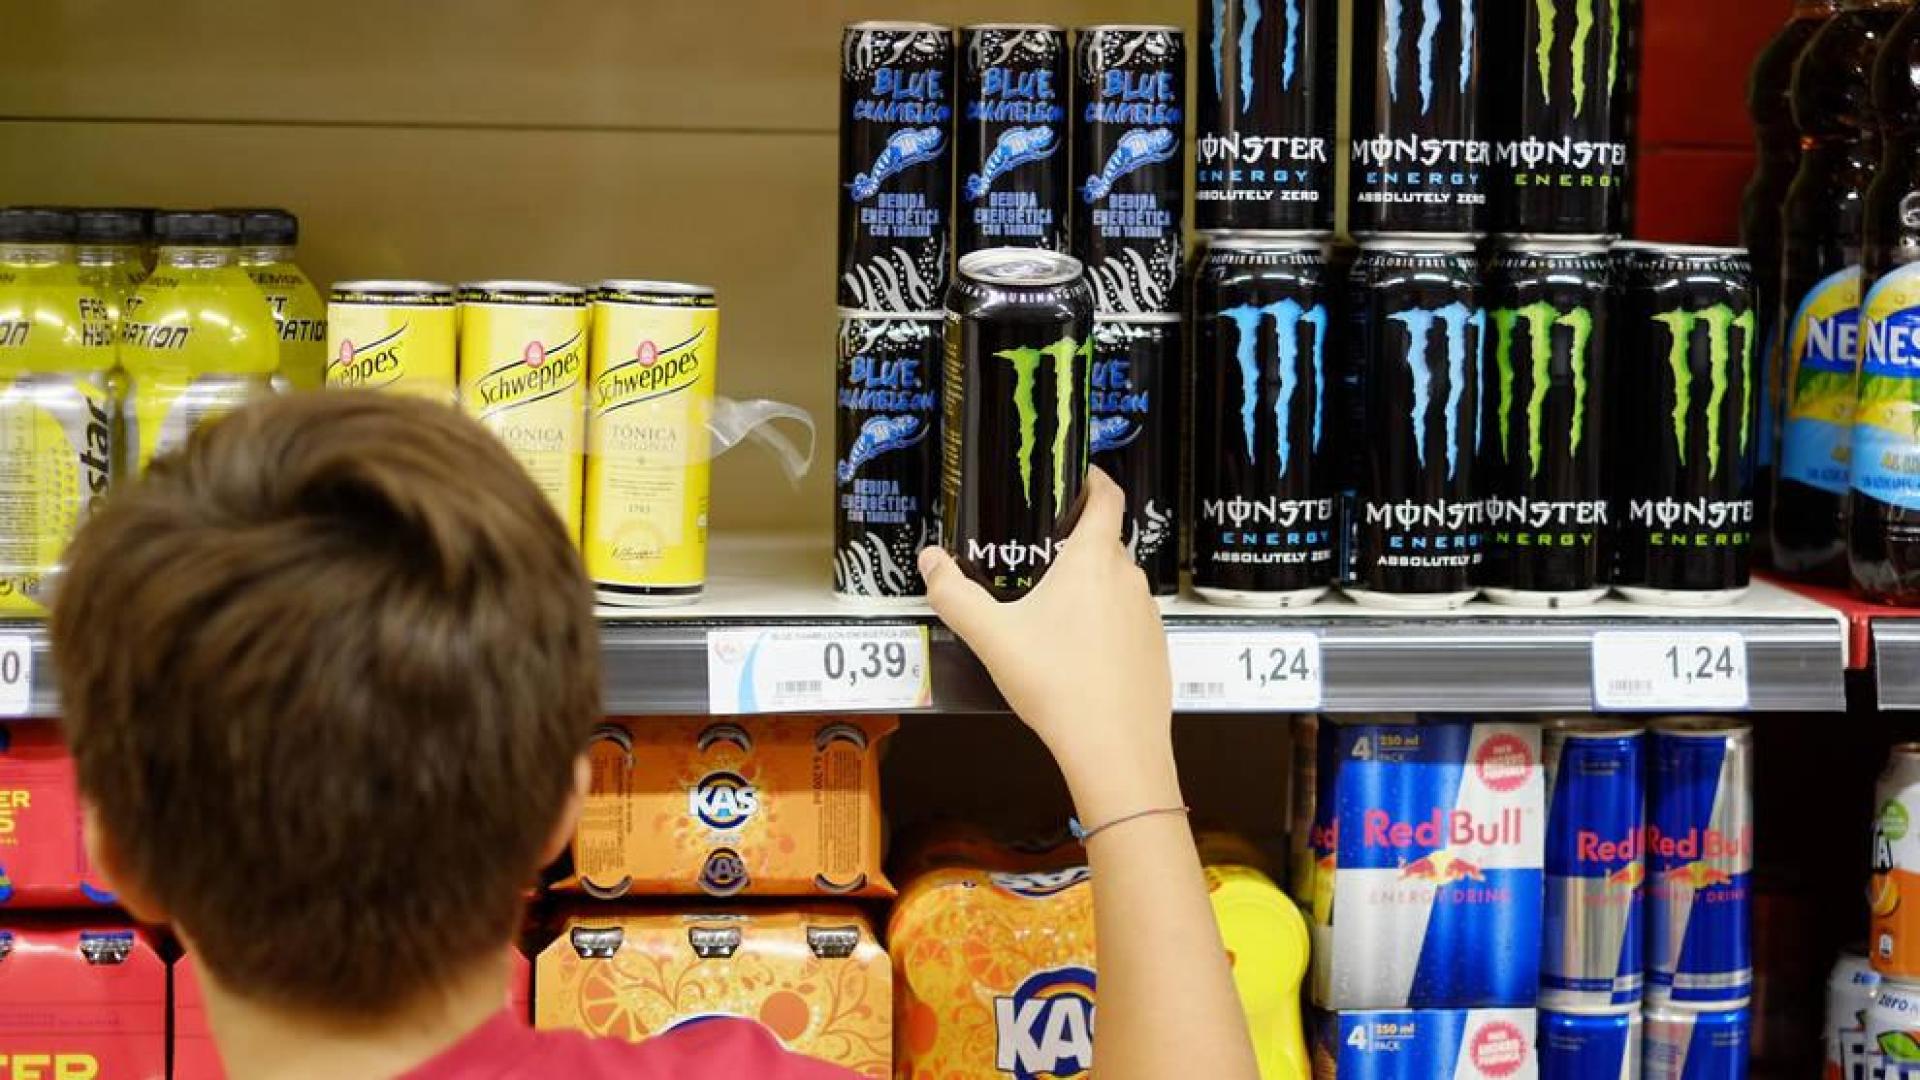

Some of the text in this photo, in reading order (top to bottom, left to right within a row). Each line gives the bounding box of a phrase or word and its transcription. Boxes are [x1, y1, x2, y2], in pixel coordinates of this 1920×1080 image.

[872, 67, 943, 100] BLUE
[982, 67, 1054, 99] BLUE
[1101, 68, 1173, 102] BLUE
[1497, 136, 1627, 168] MONSTE
[1367, 172, 1479, 185] ENERGY
[1196, 190, 1319, 201] BSOLUTELY ZERO
[1357, 193, 1451, 204] ABSOLUTELY
[479, 348, 582, 406] Schweppes
[597, 349, 700, 408] Schweppes
[849, 356, 922, 388] BLUE
[1204, 495, 1332, 528] MONSTE
[1483, 495, 1608, 528] ONSTER
[1630, 496, 1753, 528] MONSTE
[1212, 551, 1307, 564] ABSOLUTELY
[823, 641, 906, 686] 0,39
[1238, 646, 1310, 688] 1,24
[1665, 645, 1735, 684] 1,24
[1351, 736, 1371, 760] 4
[689, 785, 760, 817] KAS
[1363, 807, 1521, 847] Red Bull
[1577, 826, 1634, 862] Red
[994, 999, 1095, 1071] KA
[1347, 1025, 1367, 1050] 4
